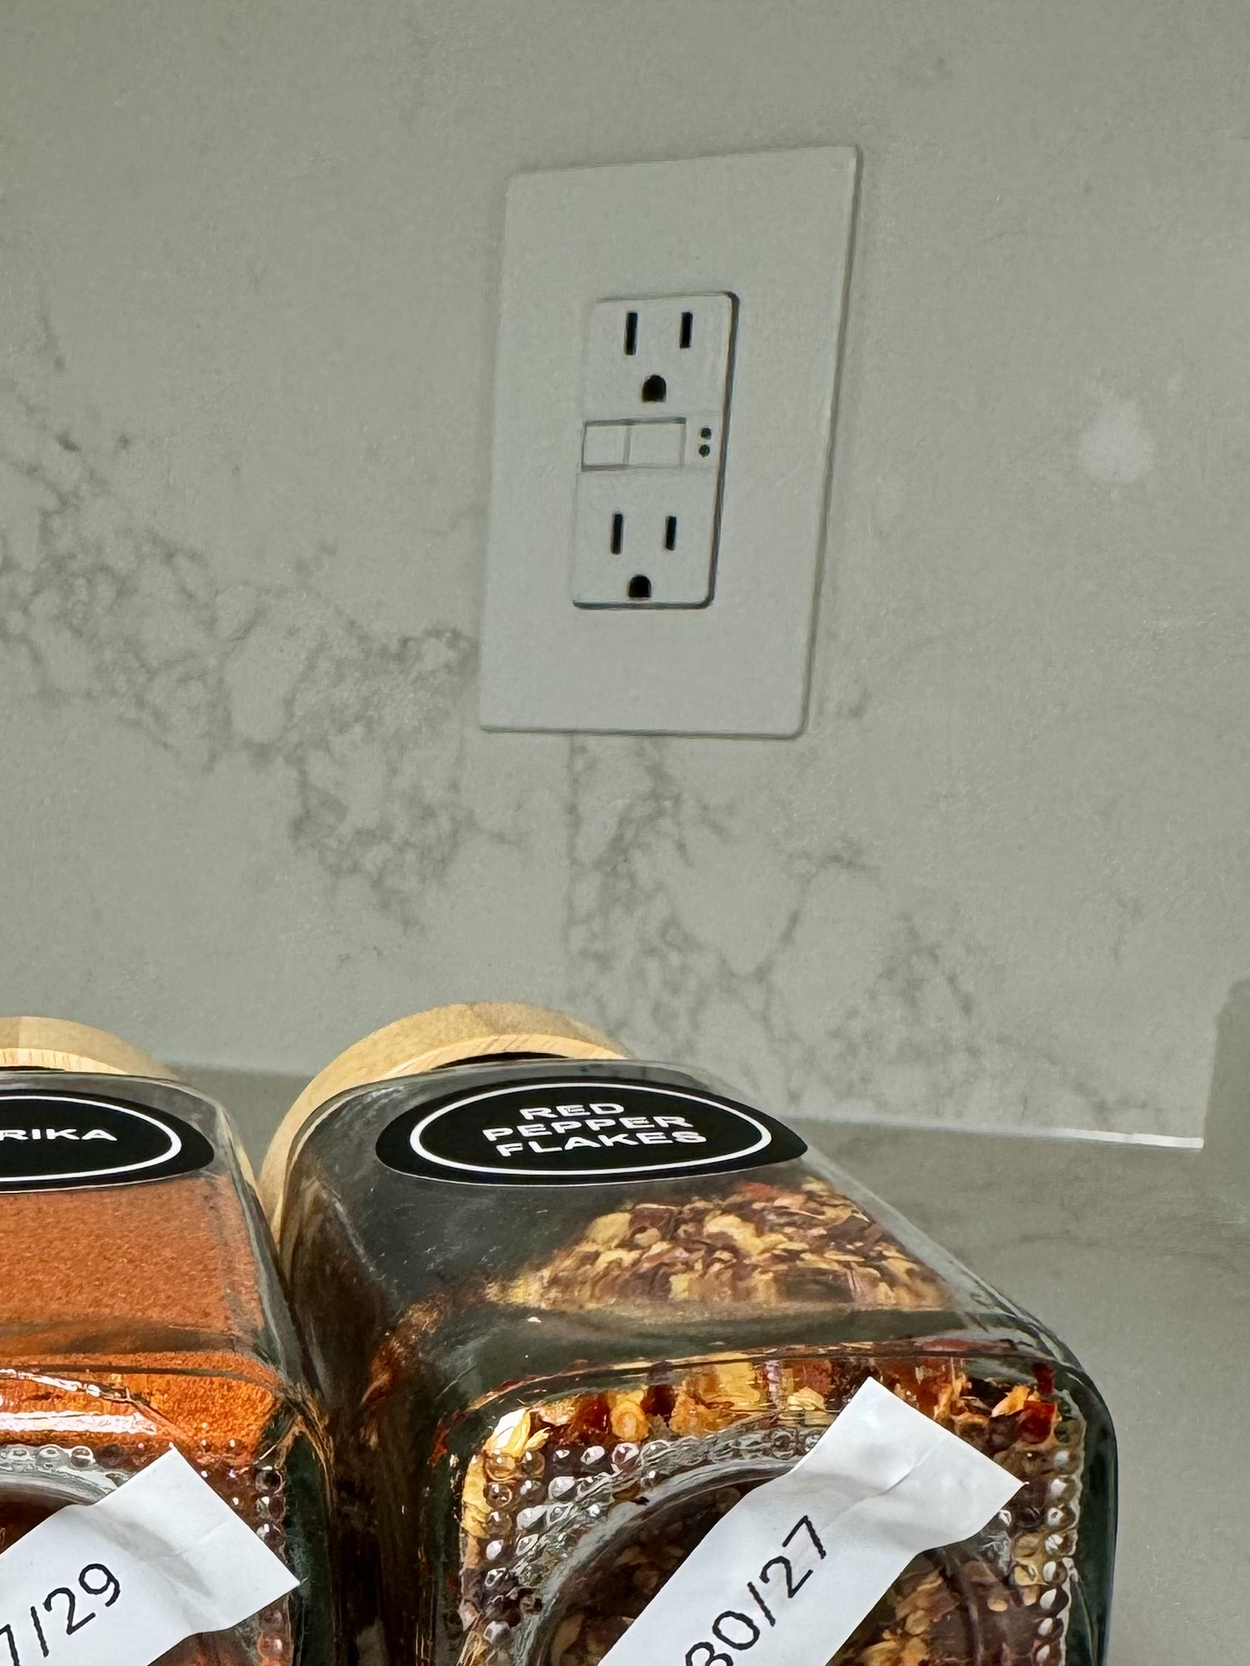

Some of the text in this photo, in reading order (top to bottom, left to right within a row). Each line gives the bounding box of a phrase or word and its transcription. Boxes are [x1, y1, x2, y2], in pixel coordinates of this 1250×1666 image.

[519, 1103, 625, 1121] RED
[482, 1115, 694, 1142] PEPPER
[495, 1130, 707, 1157] FLAKES
